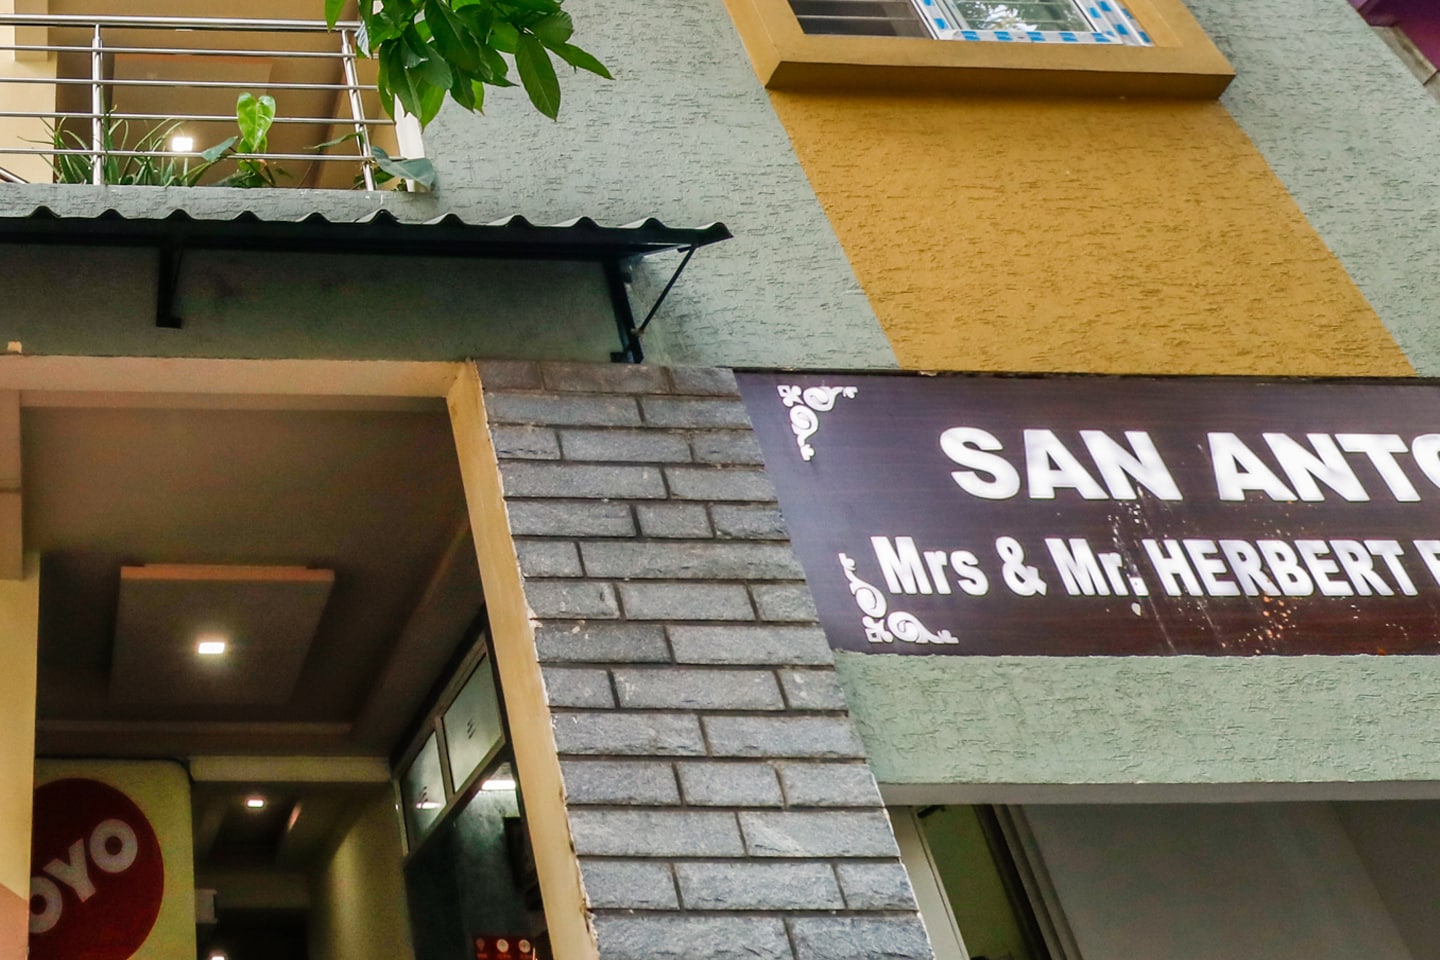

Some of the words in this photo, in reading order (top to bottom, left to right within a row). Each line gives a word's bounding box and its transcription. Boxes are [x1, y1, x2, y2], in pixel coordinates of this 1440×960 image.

[939, 426, 1183, 501] SAN
[870, 535, 989, 596] Mrs
[995, 535, 1047, 596] &
[1044, 537, 1149, 596] Mr.
[1141, 538, 1418, 597] HERBERT
[29, 818, 138, 934] OYO
